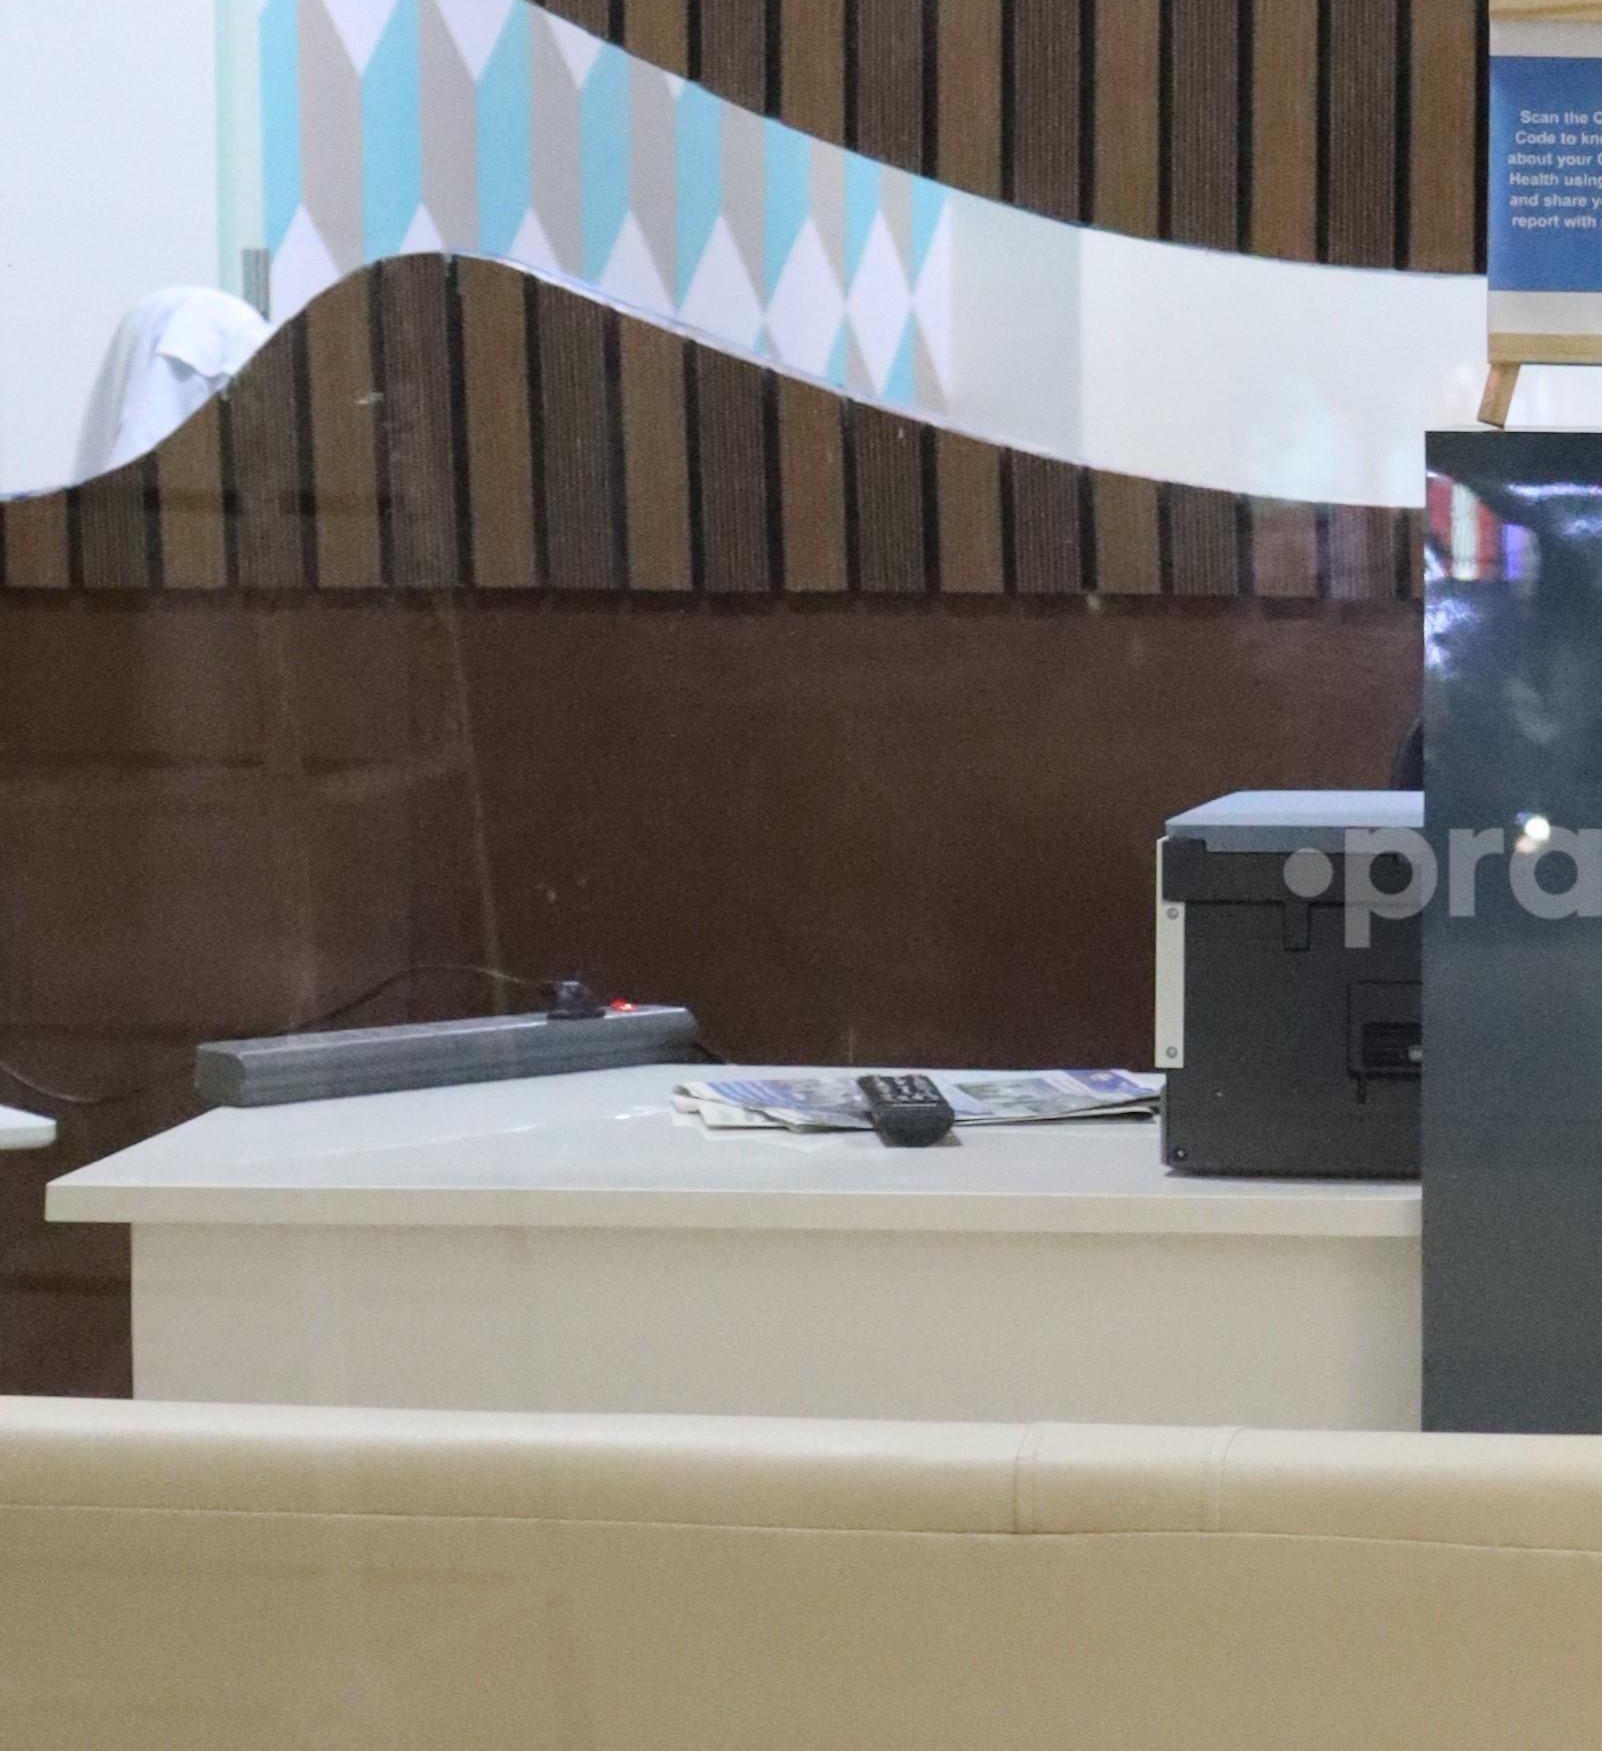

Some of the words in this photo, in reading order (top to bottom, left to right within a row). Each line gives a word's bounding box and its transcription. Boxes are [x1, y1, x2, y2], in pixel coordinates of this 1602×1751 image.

[1519, 109, 1560, 124] Scan
[1563, 111, 1589, 125] the
[1515, 130, 1556, 145] Code
[1560, 132, 1578, 146] to
[1506, 152, 1553, 166] about
[1556, 155, 1593, 169] your
[1509, 172, 1560, 186] Health
[1509, 193, 1539, 207] and
[1542, 193, 1588, 208] share
[1511, 215, 1560, 230] report
[1563, 215, 1597, 229] with
